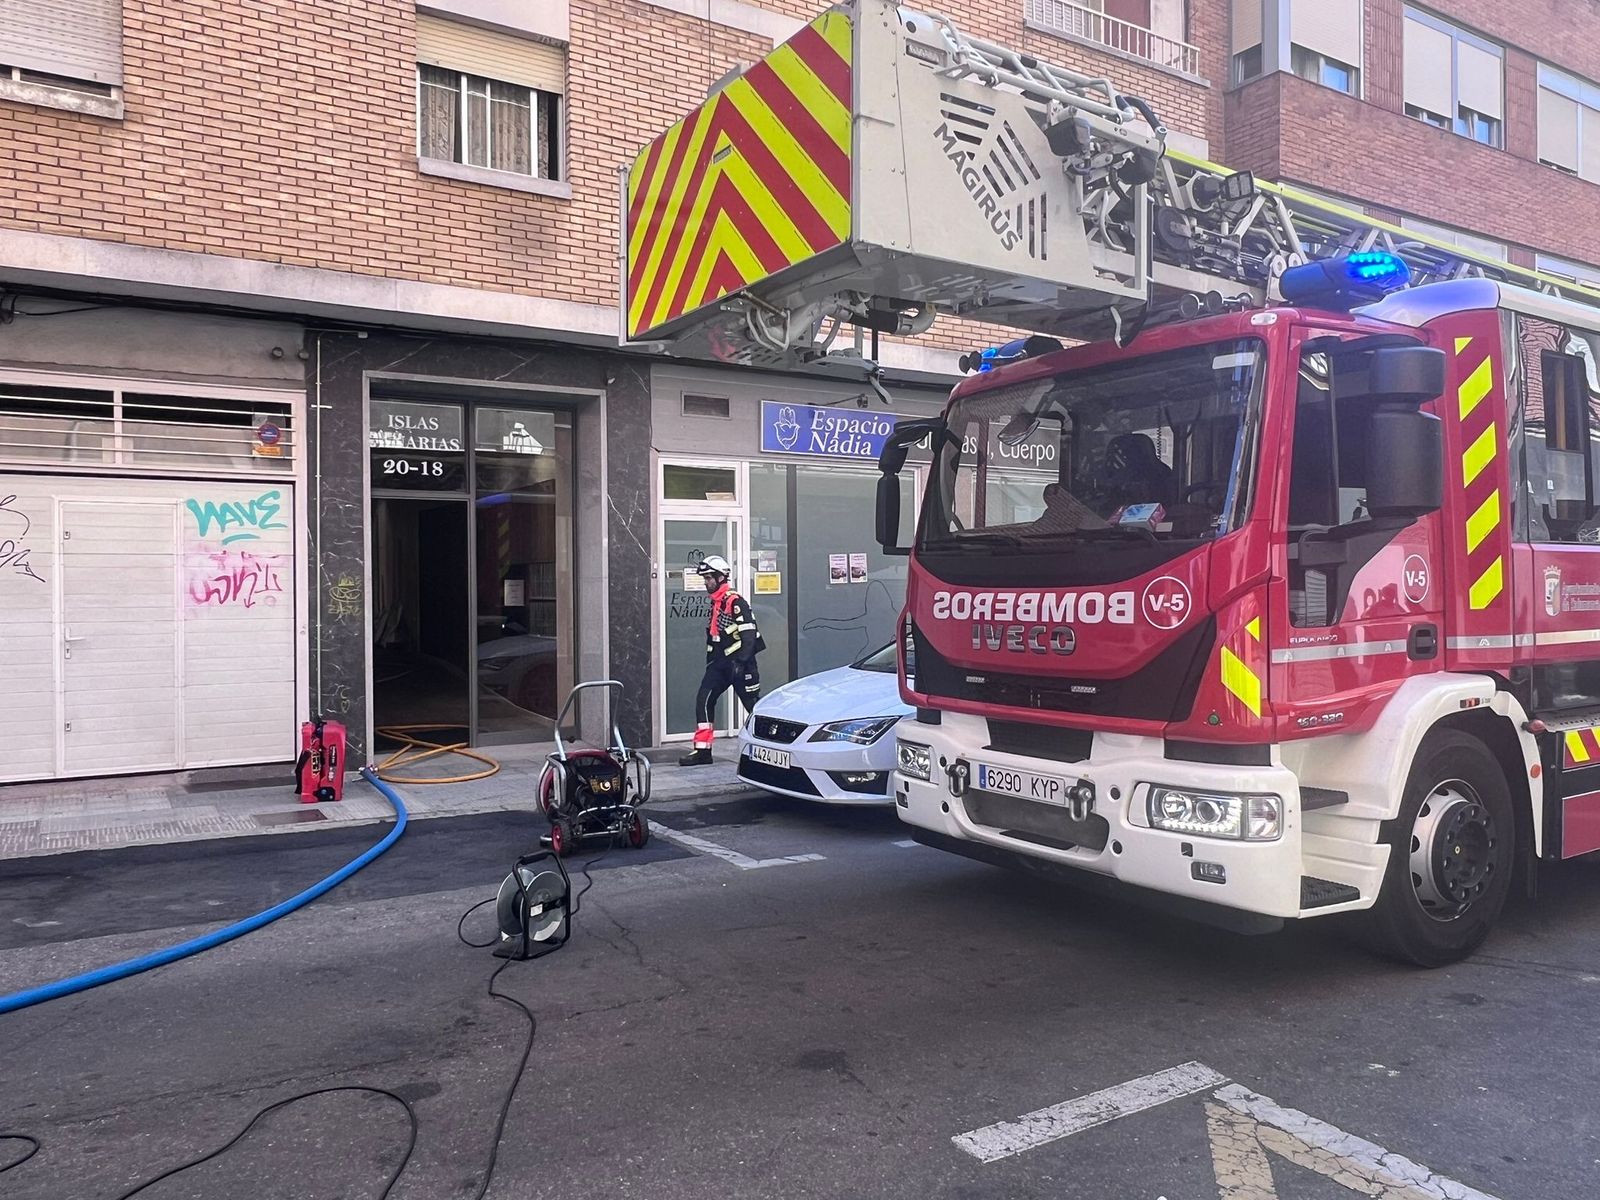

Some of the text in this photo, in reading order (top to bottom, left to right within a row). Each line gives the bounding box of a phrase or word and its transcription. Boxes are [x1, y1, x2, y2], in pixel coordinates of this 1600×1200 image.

[933, 122, 1019, 251] MAGIRUS
[387, 414, 439, 431] ISLAS
[810, 409, 890, 440] Espacio
[383, 459, 443, 476] 20-18
[1405, 570, 1426, 587] V-5
[1148, 593, 1184, 613] V-5
[971, 623, 1076, 656] IVECO
[753, 746, 788, 767] 4424 JJY
[988, 769, 1059, 799] 6290 KYP
